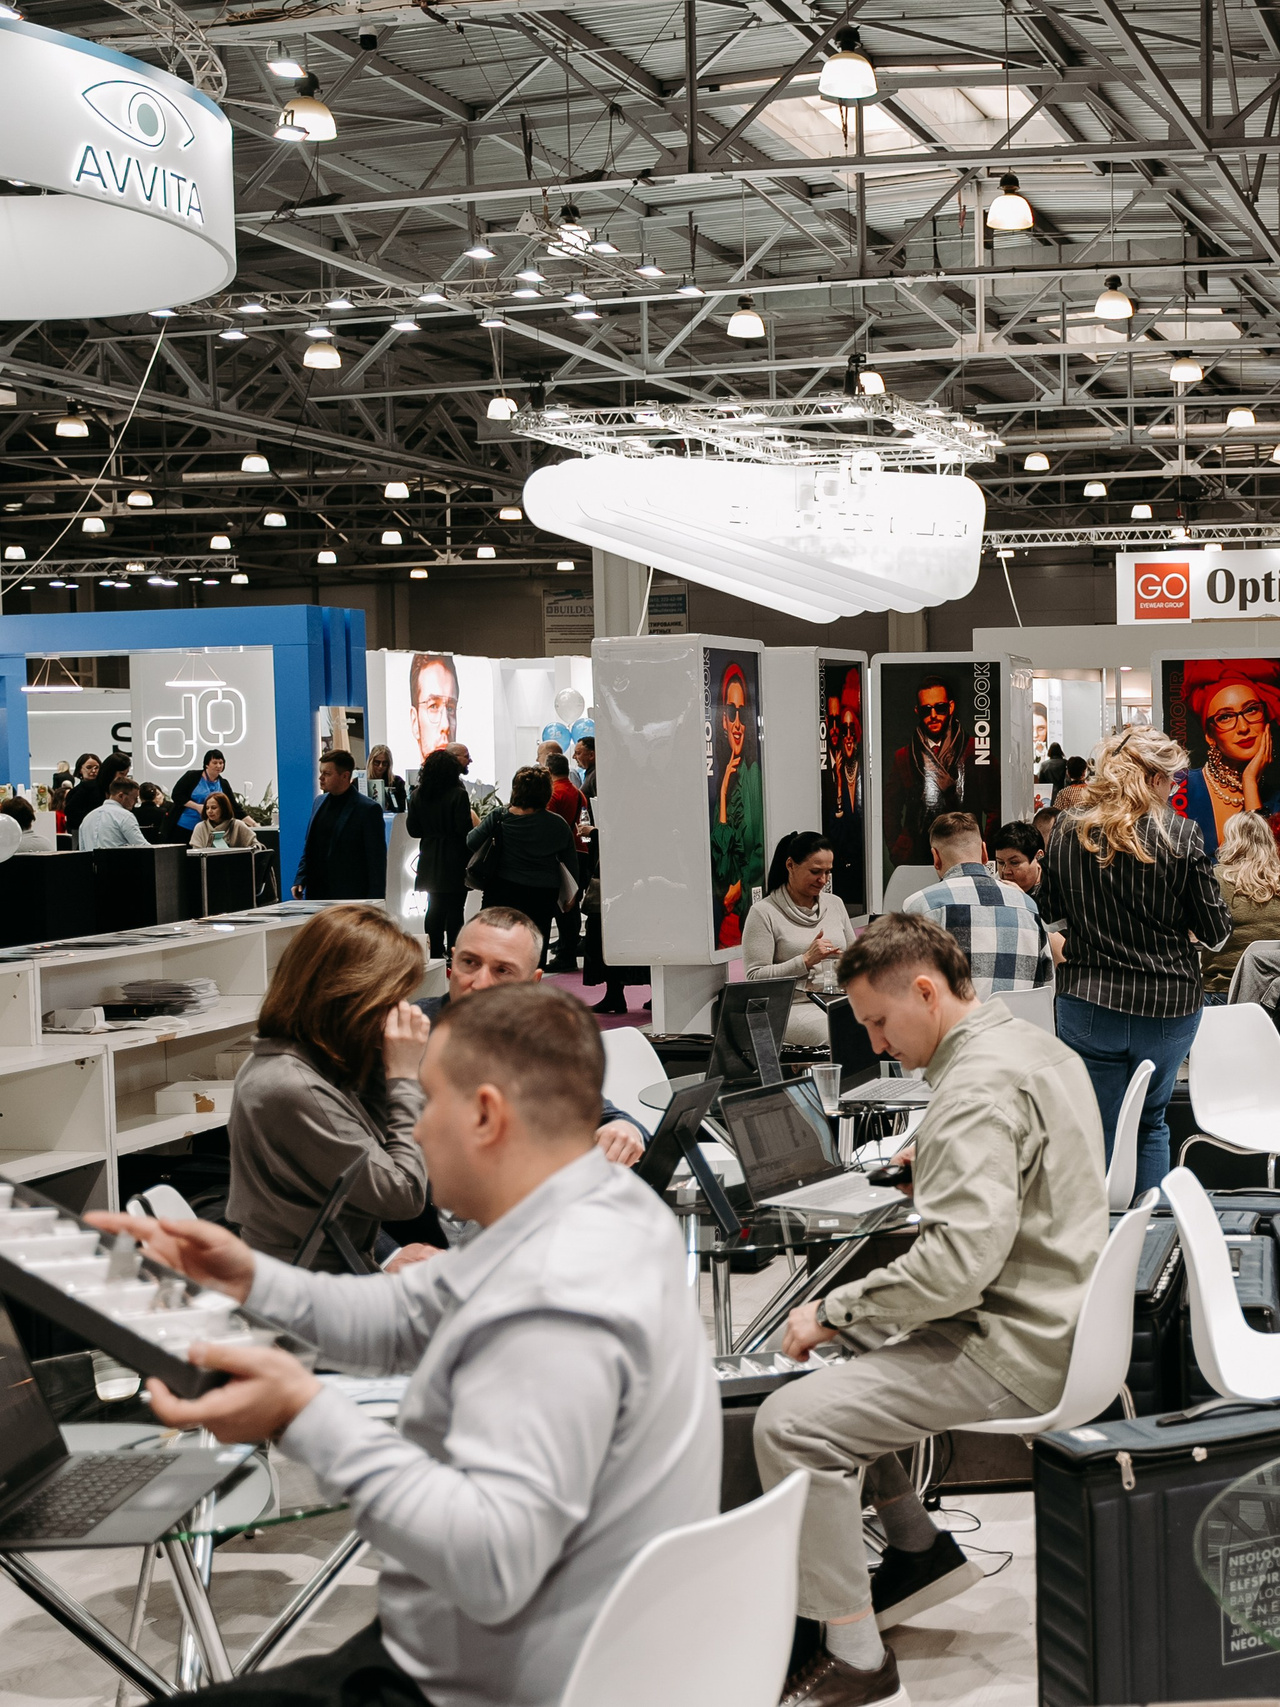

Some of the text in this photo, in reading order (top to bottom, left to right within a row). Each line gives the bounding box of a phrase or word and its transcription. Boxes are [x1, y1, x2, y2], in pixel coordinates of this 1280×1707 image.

[75, 145, 204, 224] AVVITA
[1137, 573, 1187, 600] GO
[703, 649, 714, 777] NEOLOOK
[819, 659, 828, 770] NEOLOOK
[973, 662, 991, 765] NEOLOOK
